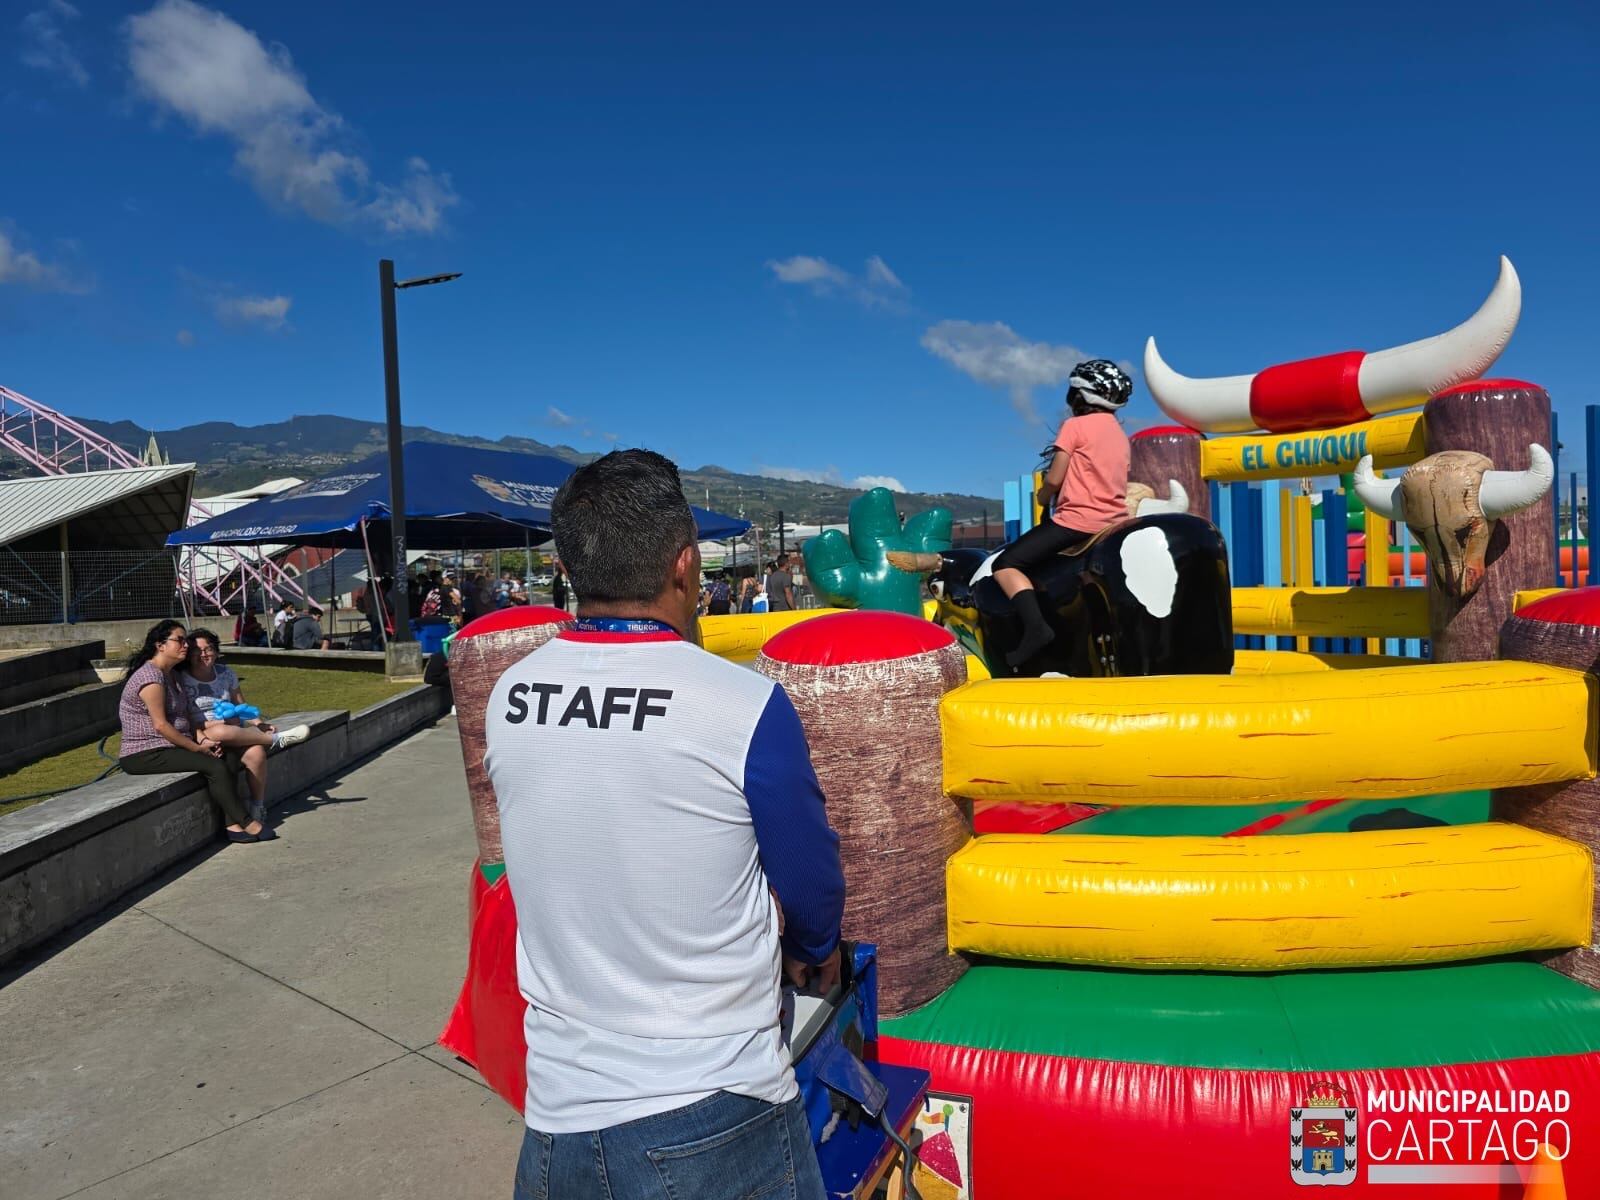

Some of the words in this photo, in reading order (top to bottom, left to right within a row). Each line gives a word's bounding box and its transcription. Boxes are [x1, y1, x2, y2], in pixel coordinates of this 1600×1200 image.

[1242, 446, 1270, 470] EL
[1276, 431, 1367, 468] CHIQUI
[626, 624, 659, 632] TIBURON
[505, 682, 674, 731] STAFF
